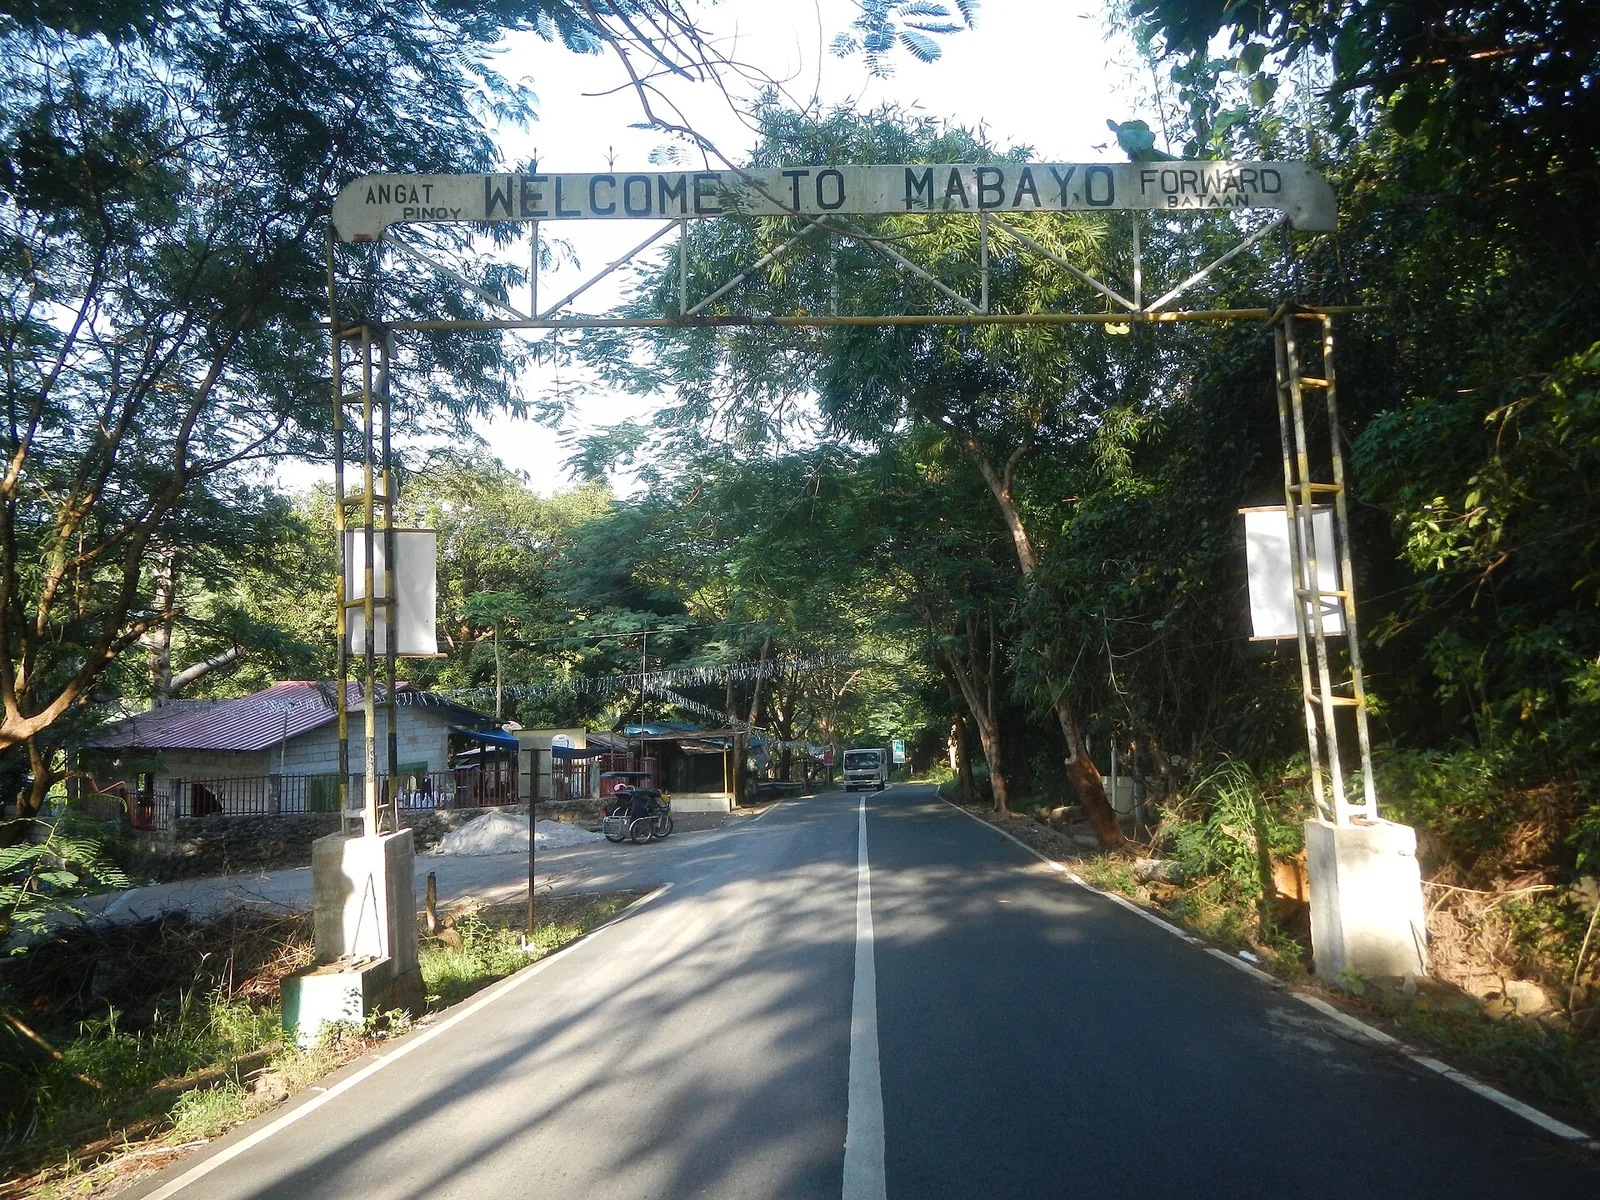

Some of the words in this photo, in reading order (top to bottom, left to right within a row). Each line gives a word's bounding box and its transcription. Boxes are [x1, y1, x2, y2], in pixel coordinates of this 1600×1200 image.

[1140, 169, 1282, 195] FORWARD
[365, 184, 434, 204] ANGAT
[484, 174, 723, 219] WELCOME
[782, 170, 846, 210] TO
[904, 166, 1115, 209] MABAYO
[1167, 194, 1249, 208] BATAAN
[402, 207, 461, 219] PINOY
